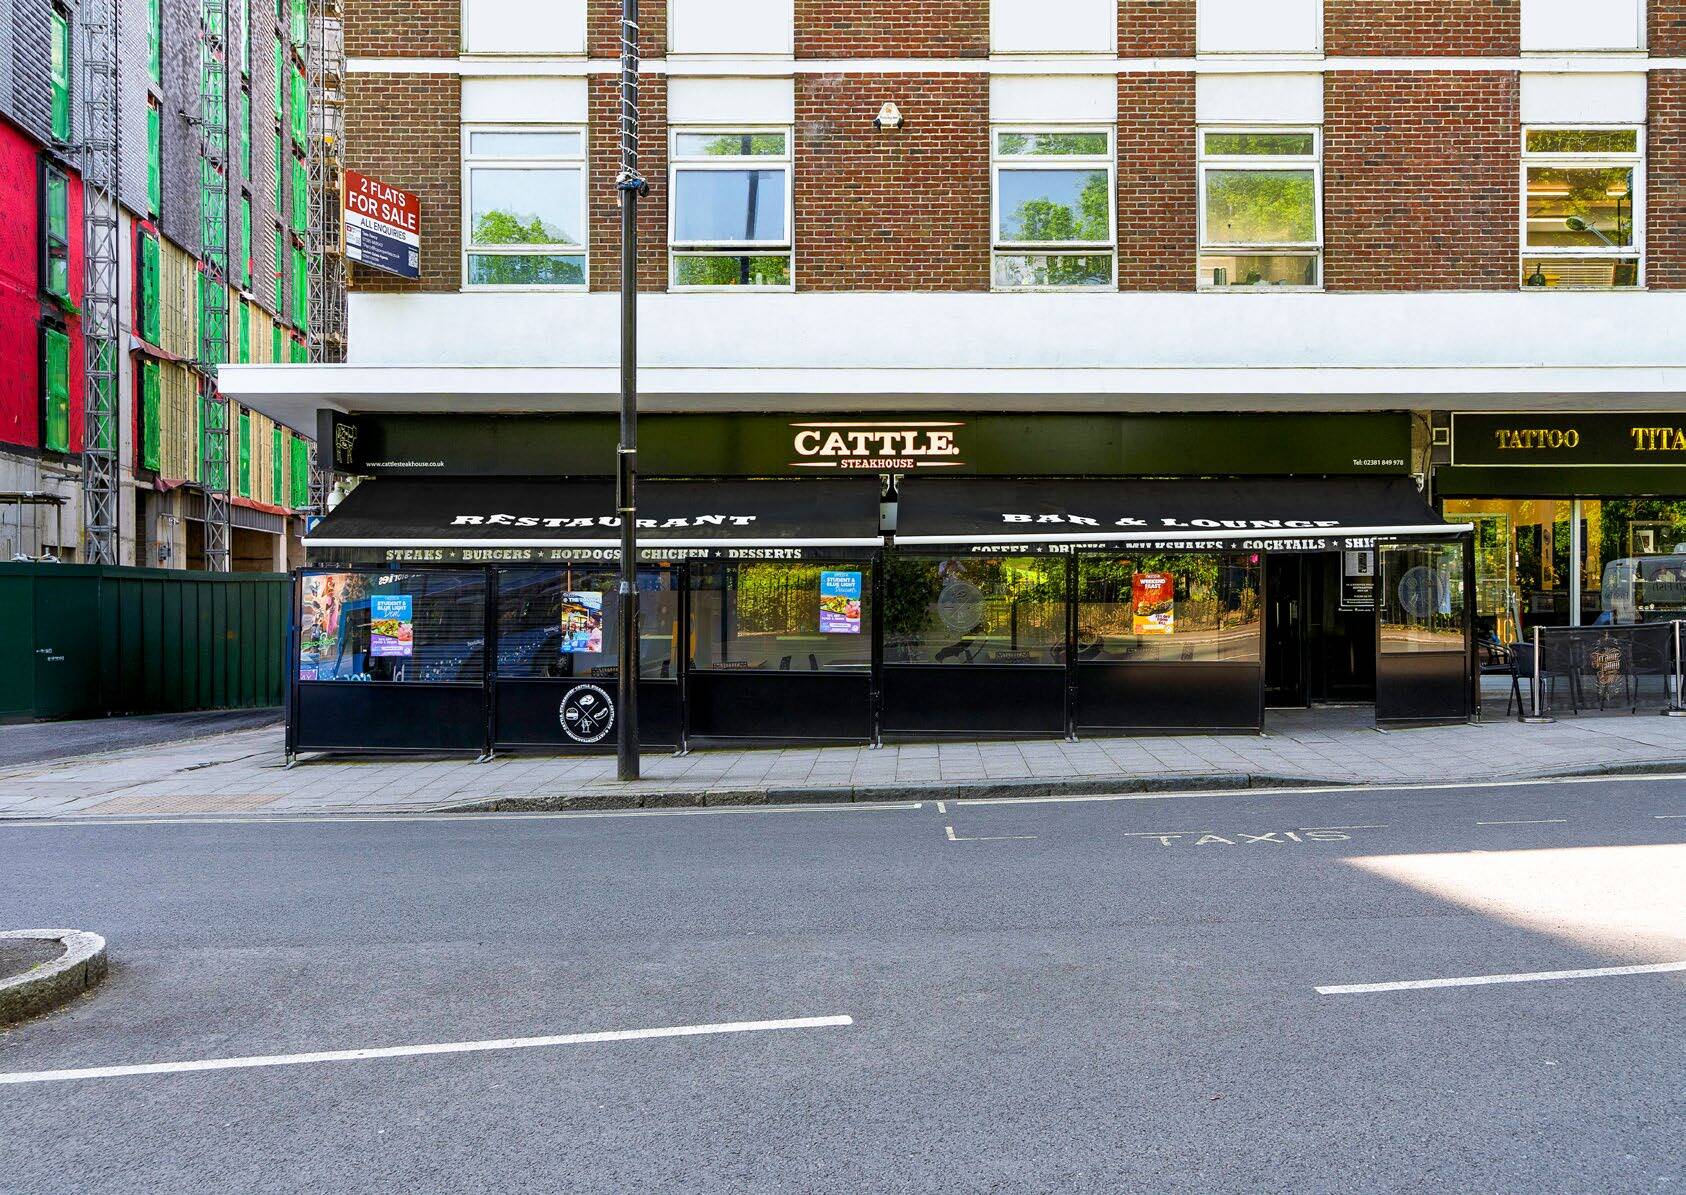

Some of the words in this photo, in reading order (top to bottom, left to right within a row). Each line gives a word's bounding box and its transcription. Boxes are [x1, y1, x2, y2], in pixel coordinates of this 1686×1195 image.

[361, 178, 368, 193] 2
[370, 182, 406, 207] FLATS
[350, 191, 378, 217] FOR
[382, 204, 416, 230] SALE
[361, 218, 372, 229] ALL
[374, 222, 406, 240] ENQUIRIES
[794, 430, 960, 456] CATTLE.
[1496, 430, 1580, 449] TATTOO
[1631, 428, 1686, 451] TITA
[366, 460, 445, 468] www.cattlesteakhouse.co.uk
[840, 459, 914, 469] STEAKHOUSE
[450, 514, 756, 528] RESTAURANT
[1002, 514, 1100, 526] BAR
[1115, 518, 1148, 526] &
[1160, 518, 1340, 528] LOUNGE
[1242, 538, 1326, 550] COCKTAILS
[386, 550, 443, 560] STEAKS
[462, 549, 531, 560] BURGERS
[550, 549, 622, 560] HOTDOGS
[641, 549, 709, 560] CHICKEN
[728, 548, 802, 559] DESSERTS
[1141, 832, 1351, 846] TAXIS
